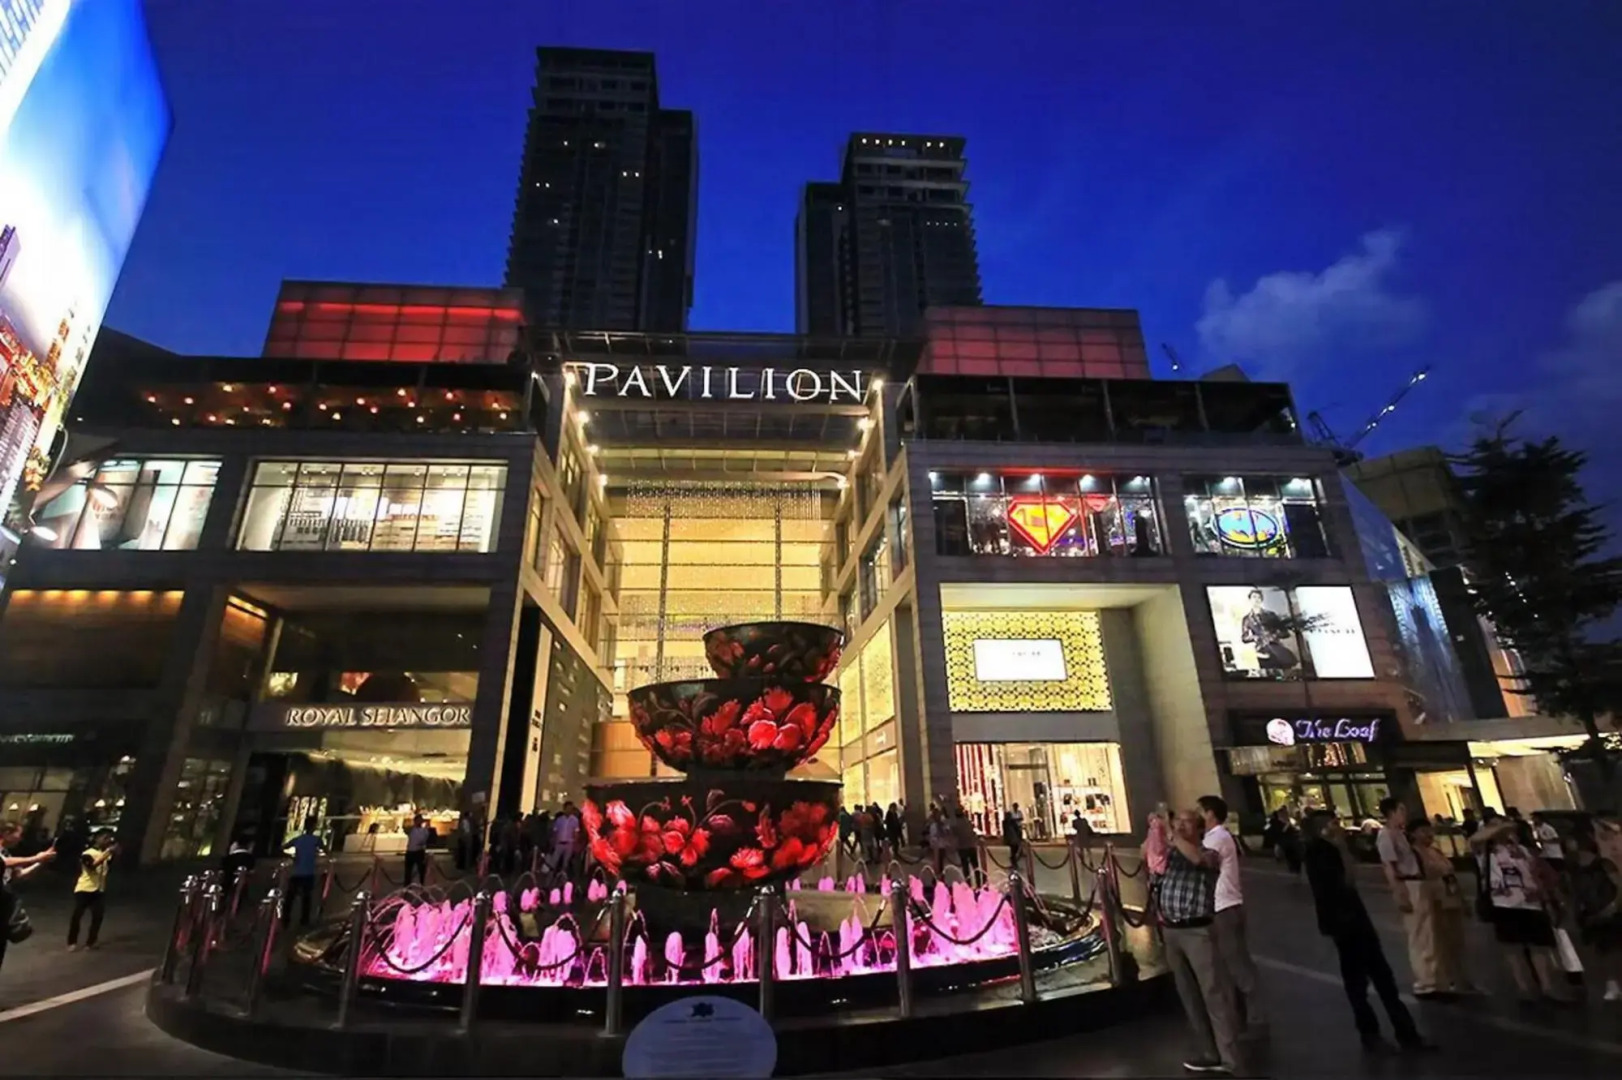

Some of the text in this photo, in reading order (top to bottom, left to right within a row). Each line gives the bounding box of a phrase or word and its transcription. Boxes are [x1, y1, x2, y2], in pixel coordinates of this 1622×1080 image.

[584, 363, 862, 402] PAVILION
[286, 707, 472, 726] ROYAL SELANGOR
[1295, 718, 1380, 742] The Loaf
